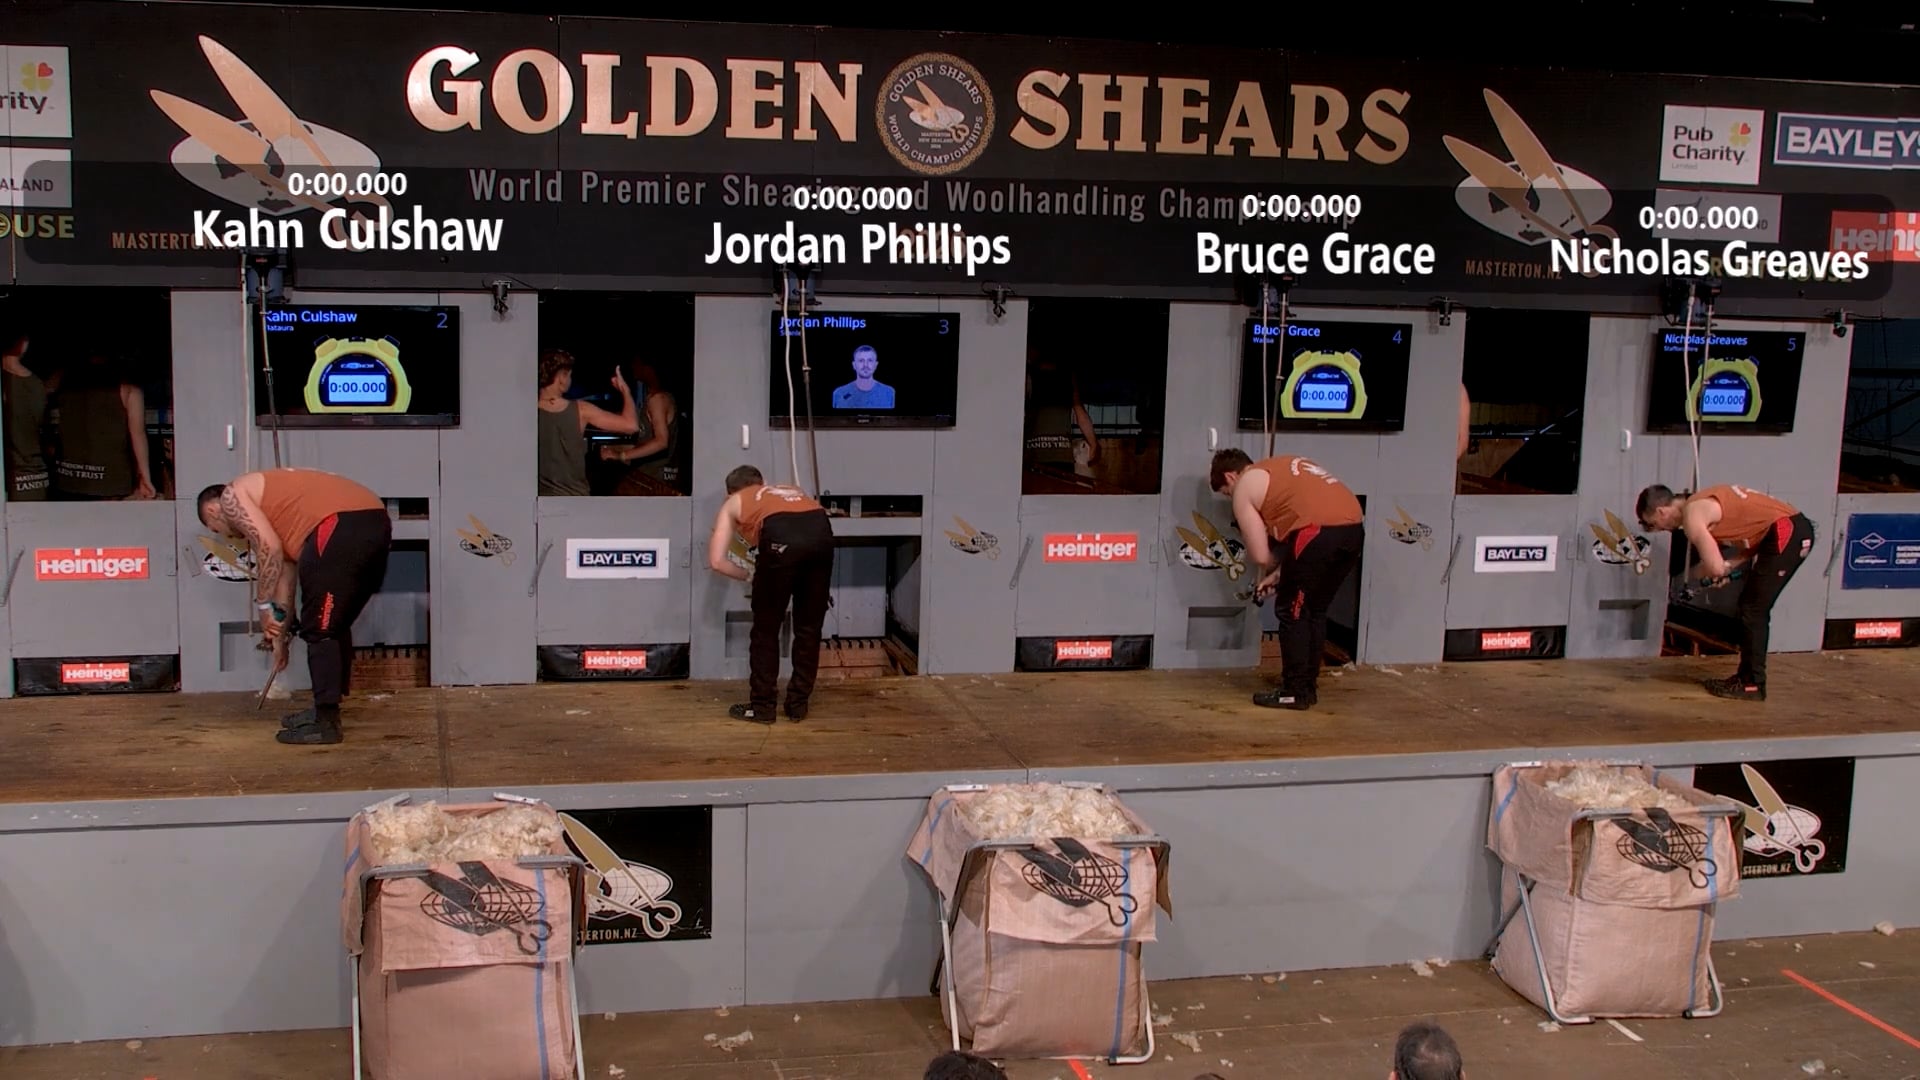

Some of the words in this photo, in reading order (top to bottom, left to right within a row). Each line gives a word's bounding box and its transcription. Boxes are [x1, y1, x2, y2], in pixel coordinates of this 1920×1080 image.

[889, 63, 935, 103] GOLDEN
[938, 64, 983, 105] SHEARS
[406, 45, 863, 143] GOLDEN
[1009, 69, 1412, 166] SHEARS
[888, 114, 911, 152] WORLD
[910, 115, 984, 164] CHAMPIONSHIPS
[1673, 125, 1713, 141] Pub
[1786, 125, 1920, 159] BAYLEY
[1672, 143, 1745, 166] Charity
[0, 177, 54, 192] ALAND
[469, 168, 563, 202] World
[581, 170, 706, 205] Premier
[945, 180, 1145, 222] Woolhandling
[1833, 212, 1920, 259] Heini
[301, 310, 358, 323] Culshaw
[436, 312, 448, 329] 2
[779, 316, 820, 330] Jordan
[823, 317, 866, 331] Phillips
[938, 319, 949, 335] 3
[1288, 325, 1321, 337] Grace
[1392, 329, 1403, 345] 4
[1664, 333, 1705, 346] Nicholas
[1708, 334, 1748, 347] Greaves
[1787, 337, 1796, 352] 5
[330, 382, 386, 393] 0:00.000
[1302, 390, 1348, 401] 0:00.000
[75, 471, 105, 480] TRUST
[1047, 533, 1136, 561] Heiniger
[1486, 548, 1545, 560] BAYLEYS
[40, 548, 147, 577] Heiniger
[582, 552, 653, 565] BAYLEYS
[1855, 621, 1899, 636] Heiniger
[1482, 632, 1530, 648] Heiniger
[1057, 641, 1111, 657] Heiniger
[587, 650, 646, 668] Heiniger
[65, 663, 129, 681] Heiniger
